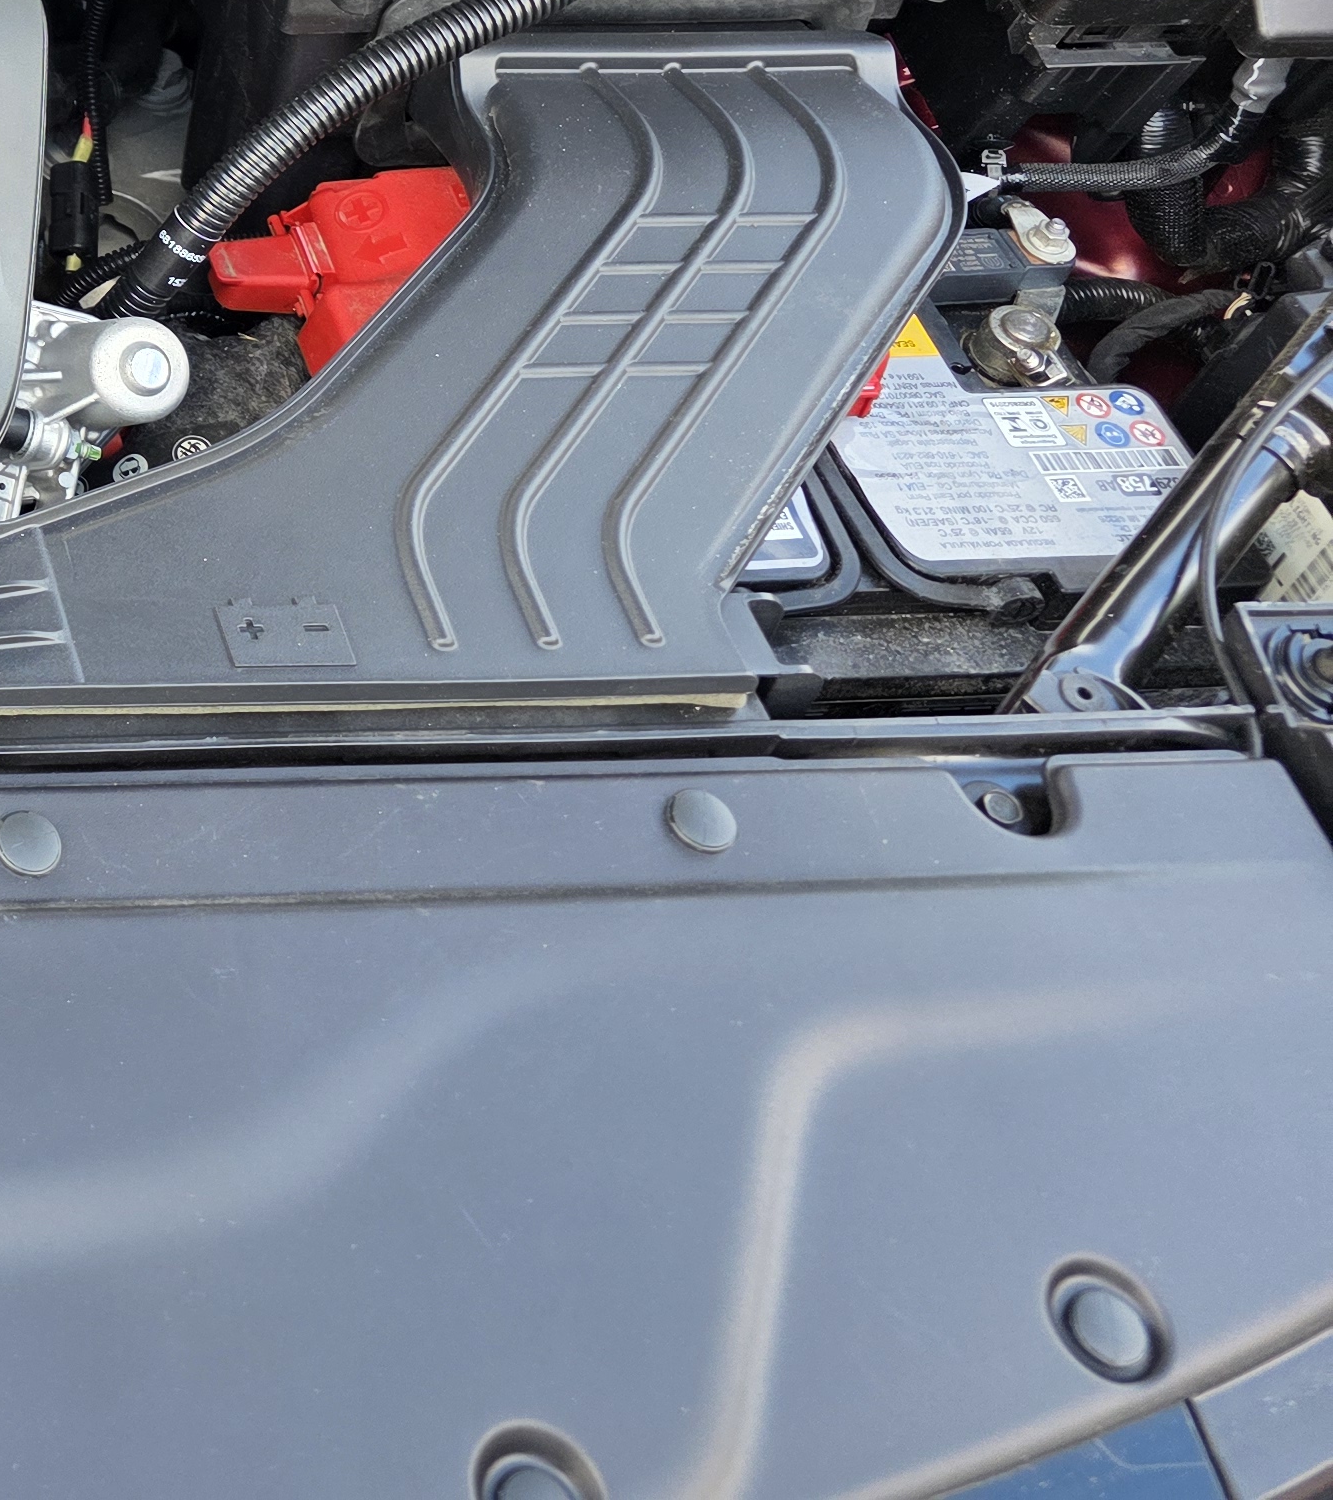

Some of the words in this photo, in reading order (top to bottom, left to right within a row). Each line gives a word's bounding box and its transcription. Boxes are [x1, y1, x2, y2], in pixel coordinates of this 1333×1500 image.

[892, 382, 918, 390] ABNT
[920, 381, 957, 390] Normas
[923, 391, 946, 399] SAC
[905, 482, 925, 490] EUA
[955, 491, 971, 499] por
[894, 505, 910, 516] kg
[972, 505, 991, 514] 100
[1038, 504, 1057, 512] RC
[905, 517, 958, 528] (SAE/EN)
[1011, 515, 1038, 524] CCA
[1041, 514, 1061, 523] 650
[982, 526, 1013, 537] 65Ah
[1022, 526, 1043, 535] 12V
